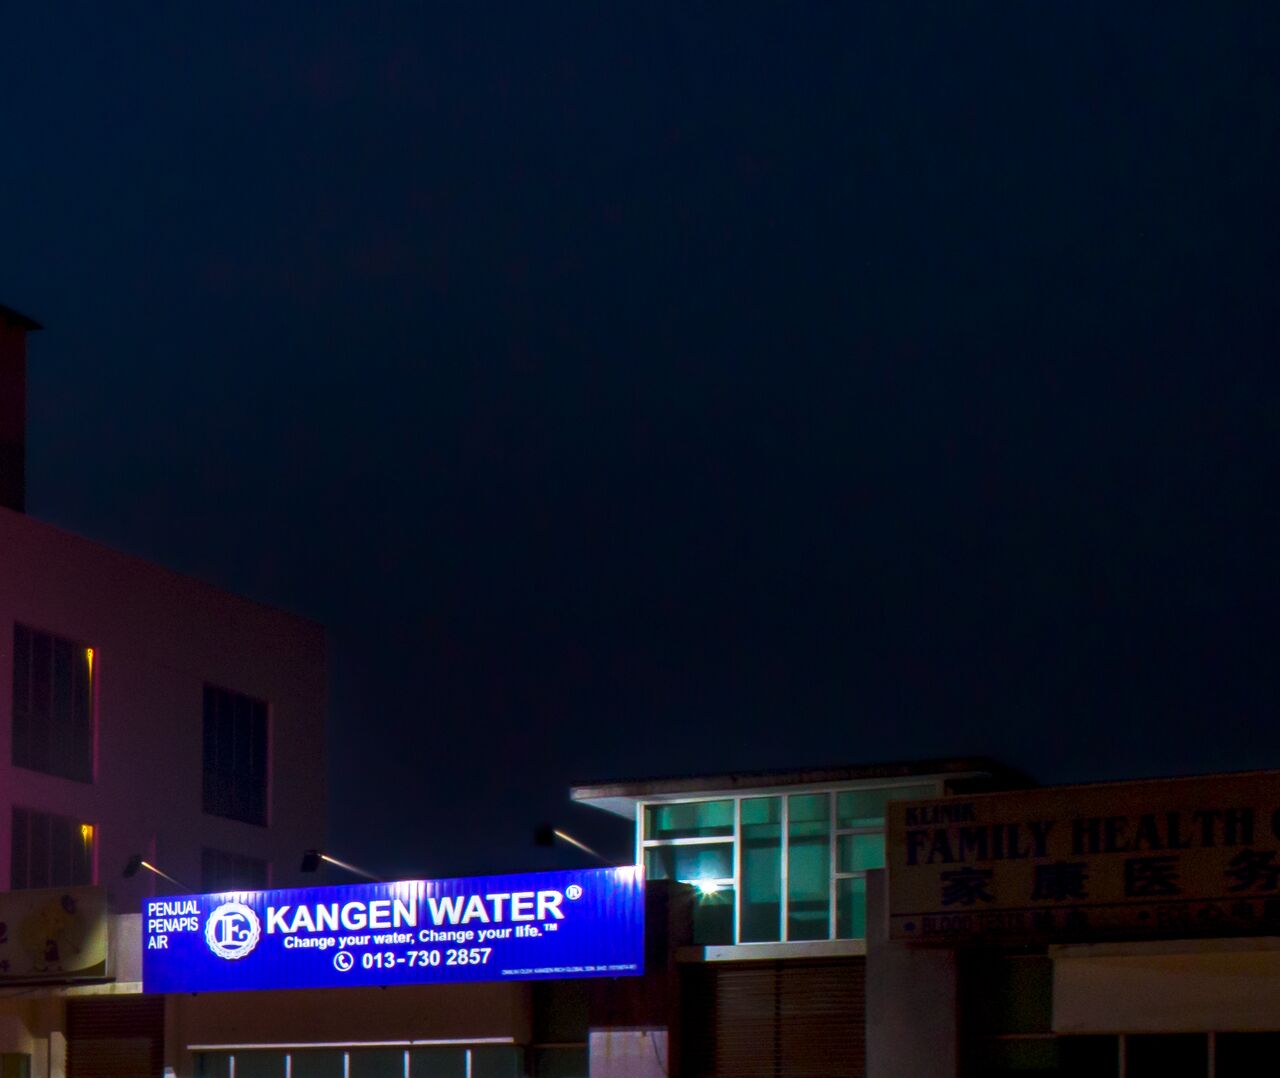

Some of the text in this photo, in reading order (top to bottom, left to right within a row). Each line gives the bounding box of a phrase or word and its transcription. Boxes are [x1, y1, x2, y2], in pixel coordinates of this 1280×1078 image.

[905, 807, 1258, 867] FAMILY HEALTH
[148, 900, 201, 918] PENJUAL
[266, 899, 418, 935] KANGEN
[148, 917, 200, 934] PENAPIS
[148, 934, 169, 951] AIR
[283, 934, 337, 950] Change
[339, 936, 372, 949] your
[373, 930, 415, 947] water,
[419, 928, 468, 945] Change
[471, 929, 502, 943] your
[361, 947, 493, 970] 013-730 2857
